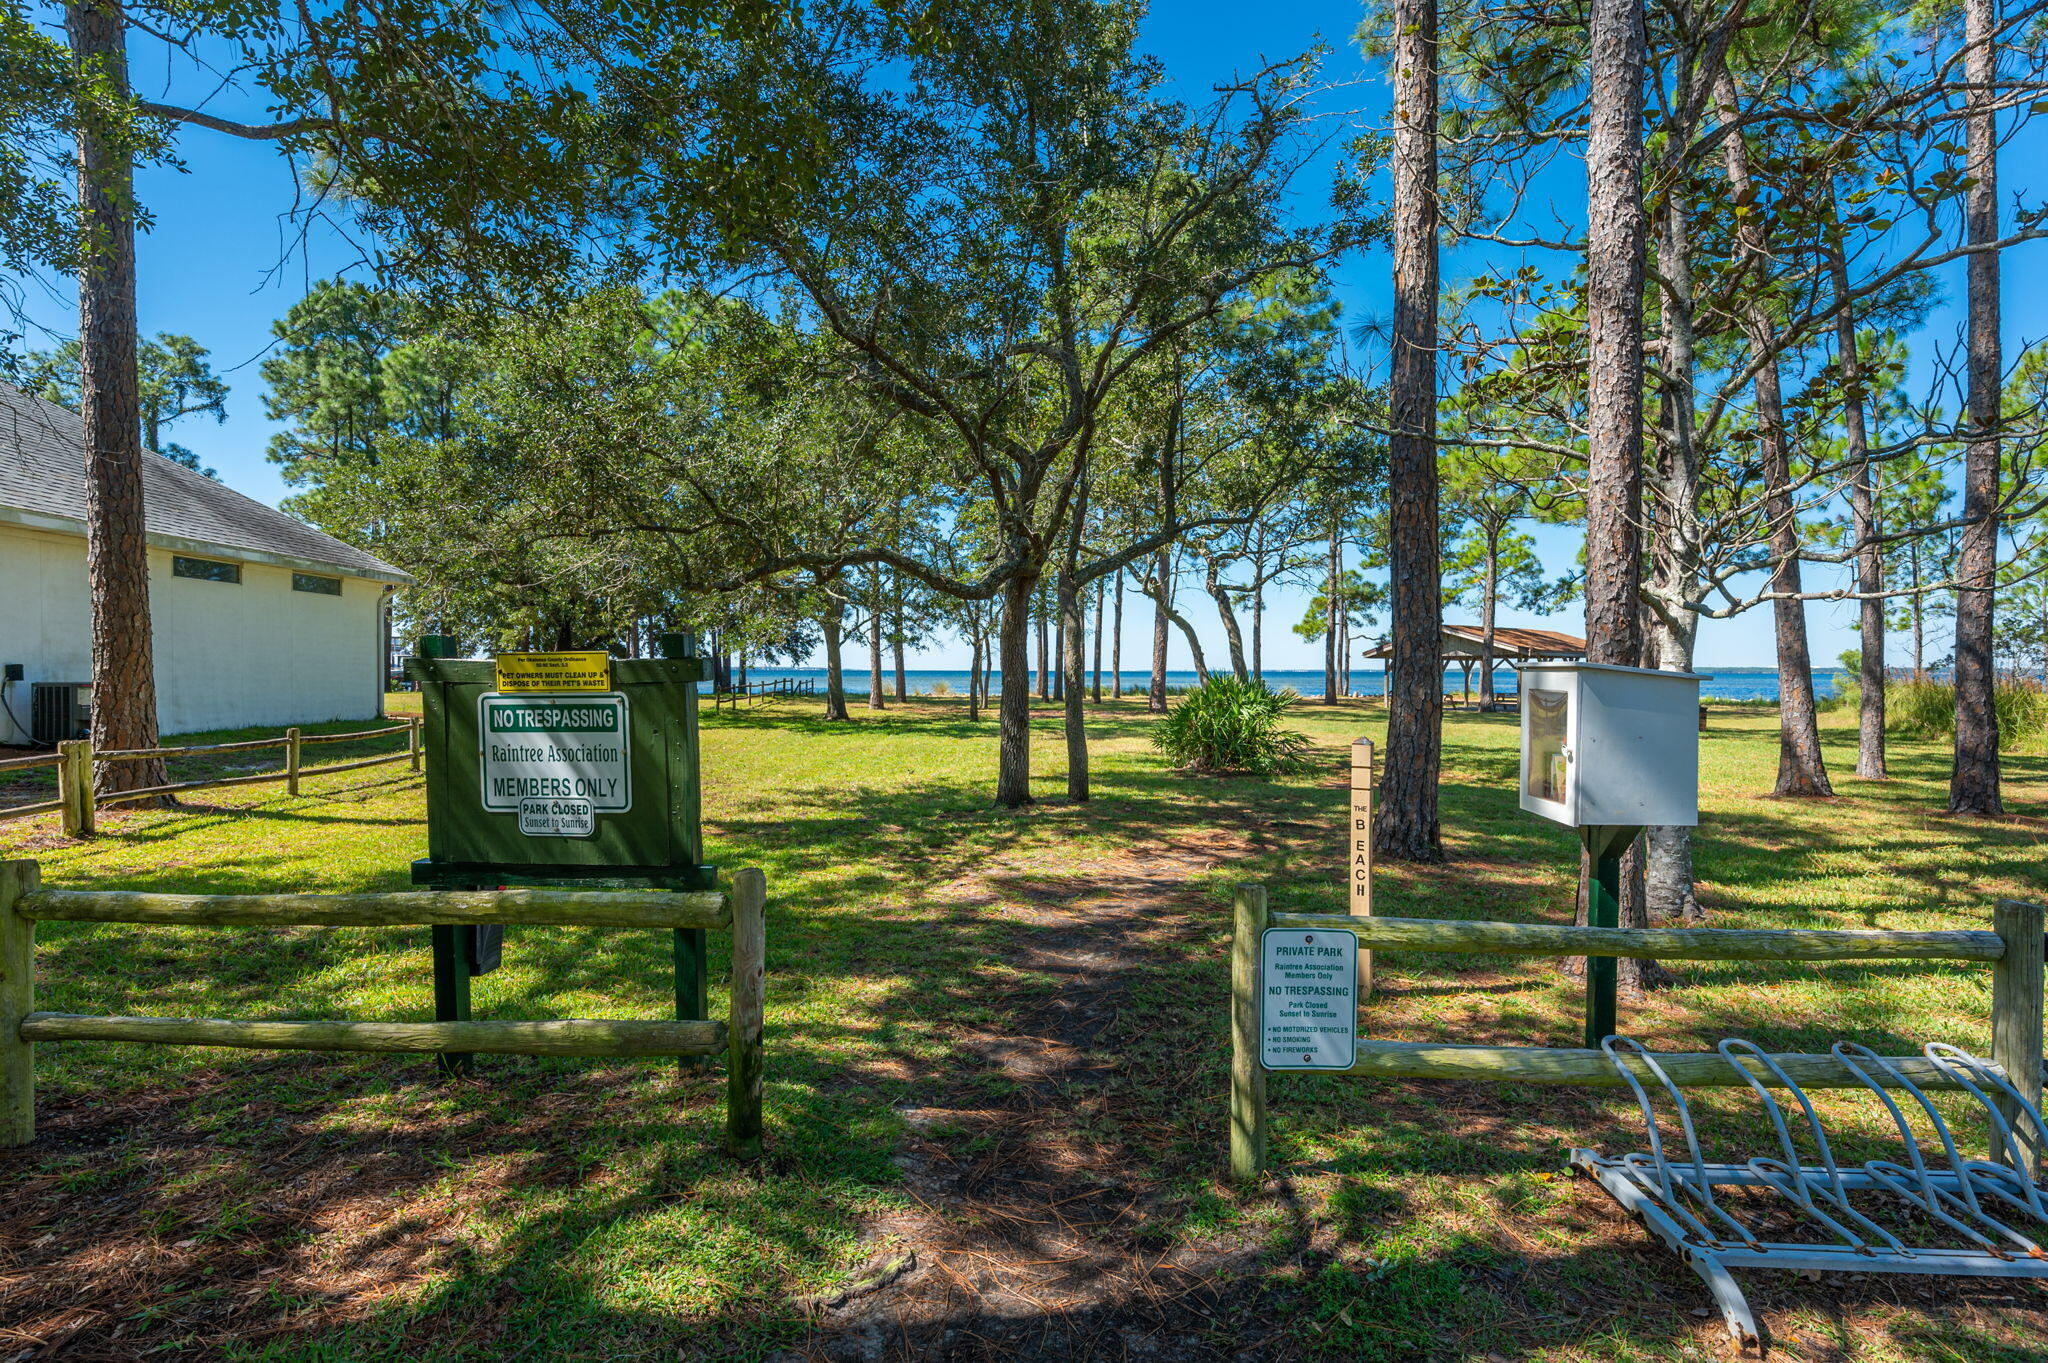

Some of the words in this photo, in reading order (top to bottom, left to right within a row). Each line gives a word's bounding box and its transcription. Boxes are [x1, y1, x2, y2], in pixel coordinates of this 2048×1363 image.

[494, 710, 514, 728] NO
[516, 709, 613, 728] TRESPASSING
[492, 744, 544, 762] Raintree
[548, 744, 618, 762] Association
[494, 778, 571, 796] MEMBERS
[575, 778, 617, 797] ONLY
[524, 804, 548, 815] PARK
[552, 804, 588, 815] CLOSED
[525, 817, 549, 828] Sunset
[551, 818, 559, 828] to
[561, 817, 588, 828] Sunrise
[1356, 820, 1366, 896] BEACH
[1276, 947, 1314, 956] PRIVATE
[1318, 948, 1342, 956] PARK
[1318, 972, 1332, 980] Only
[1269, 987, 1281, 995] NO
[1285, 987, 1349, 996] TRESPASSING
